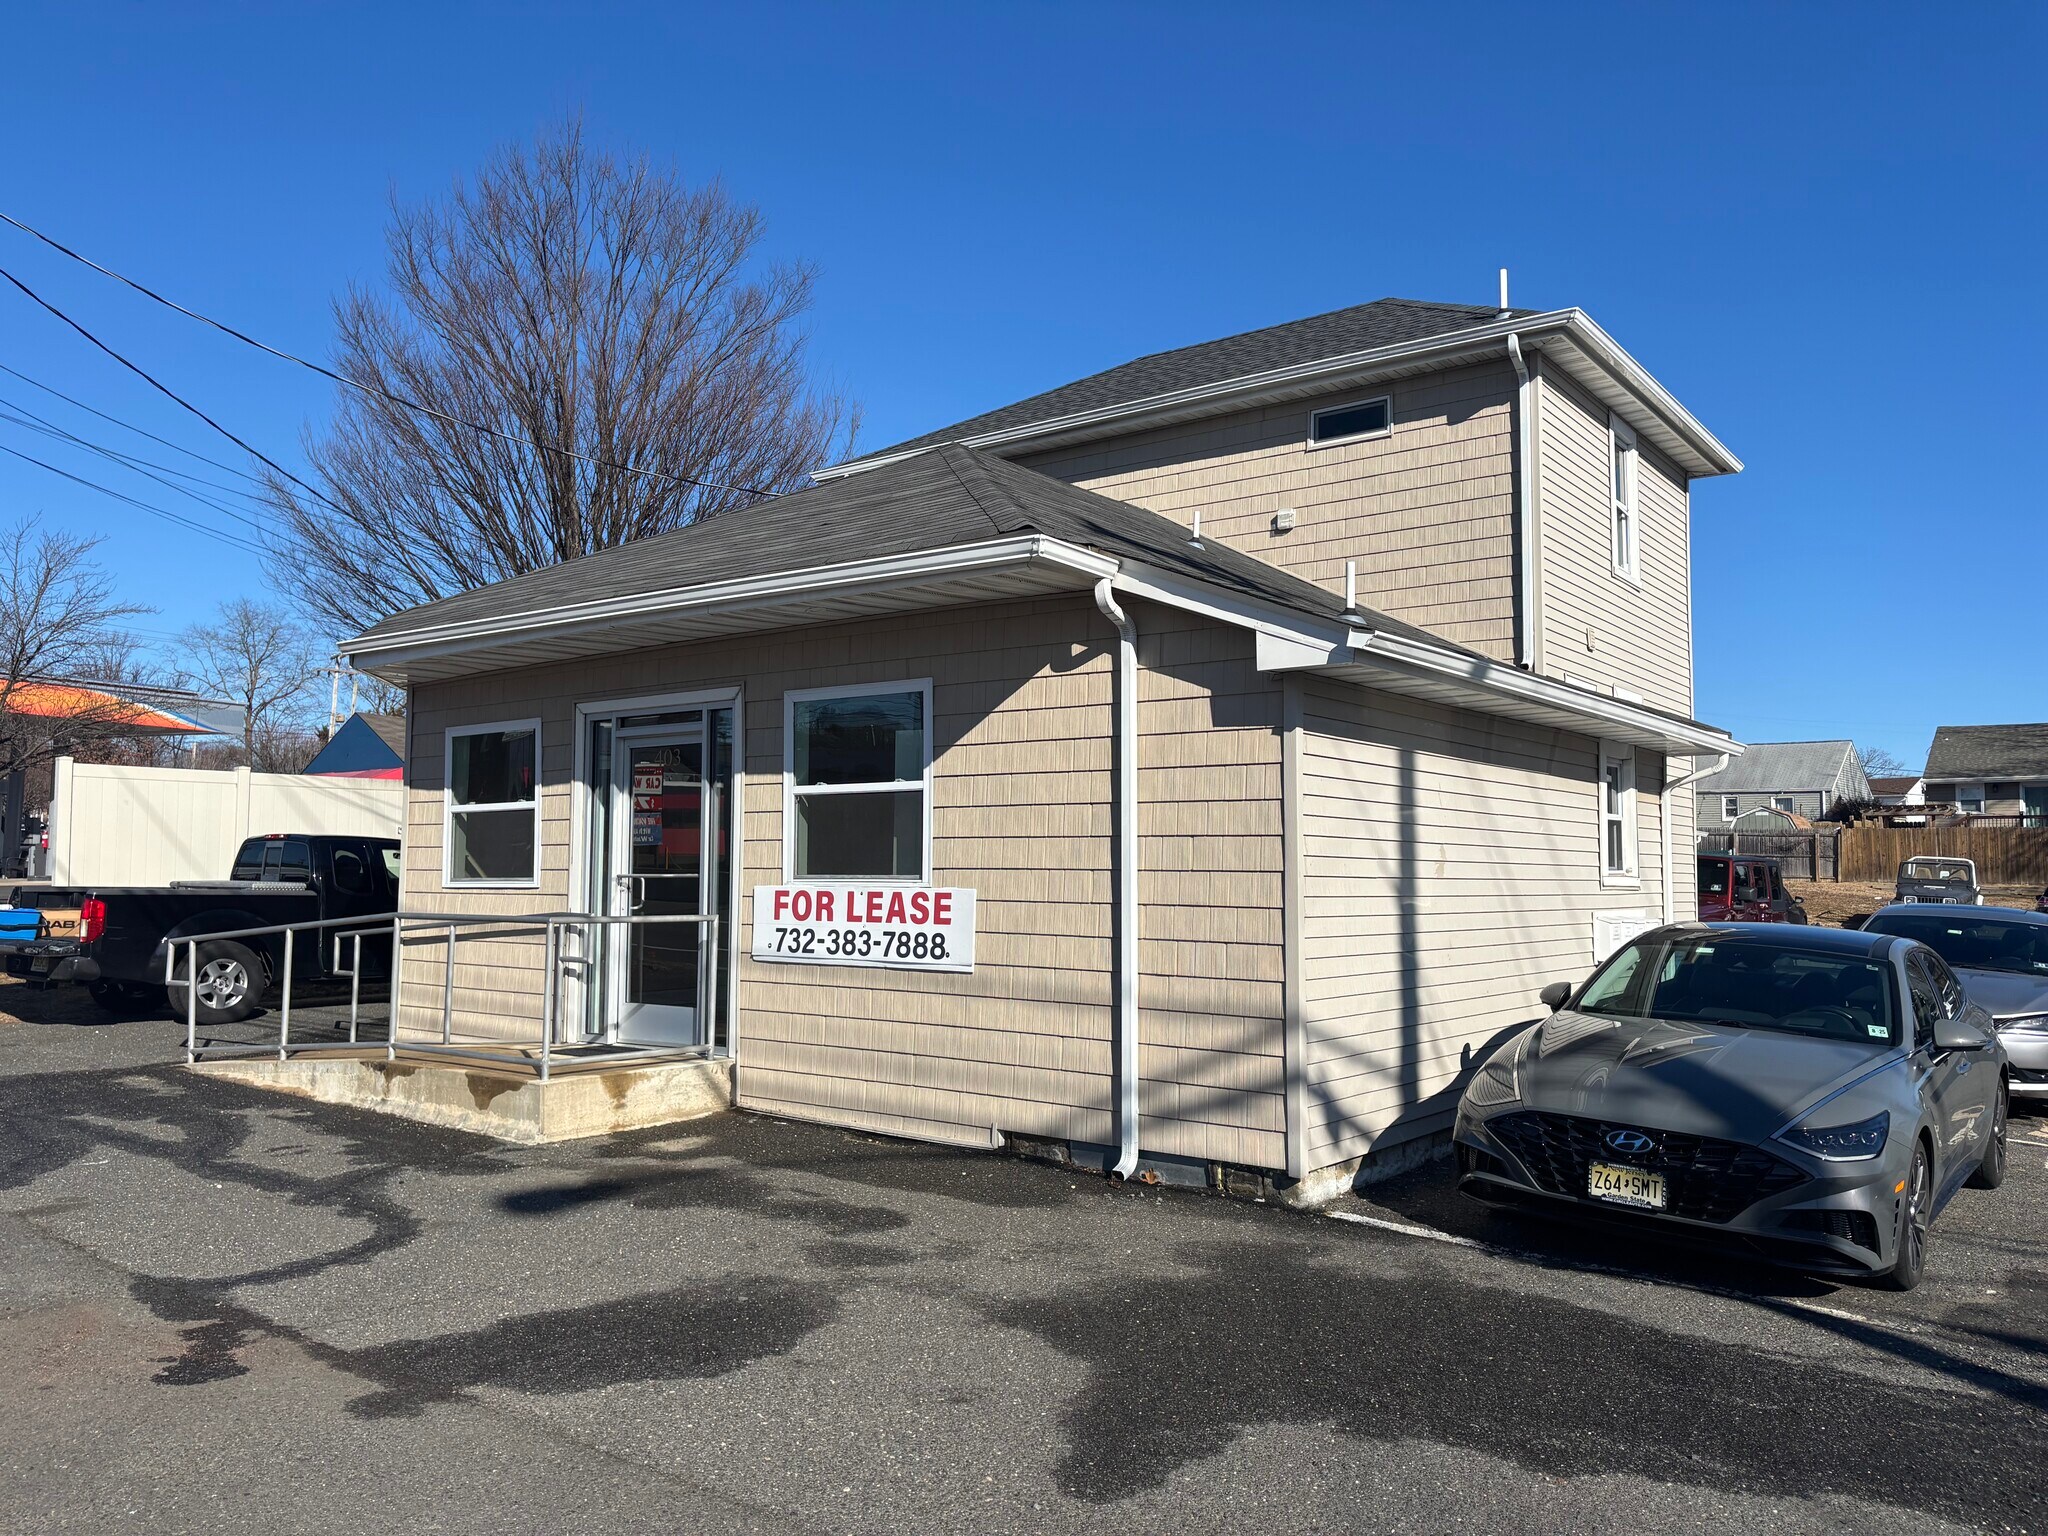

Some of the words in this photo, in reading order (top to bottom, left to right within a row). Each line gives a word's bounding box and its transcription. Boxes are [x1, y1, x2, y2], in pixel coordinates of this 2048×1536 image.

[654, 749, 681, 767] 403
[773, 890, 835, 922] FOR
[846, 891, 952, 925] LEASE
[775, 927, 946, 960] 732-383-7888
[1594, 1170, 1621, 1192] Z64
[1631, 1177, 1659, 1199] SMT
[1607, 1191, 1629, 1201] Garden
